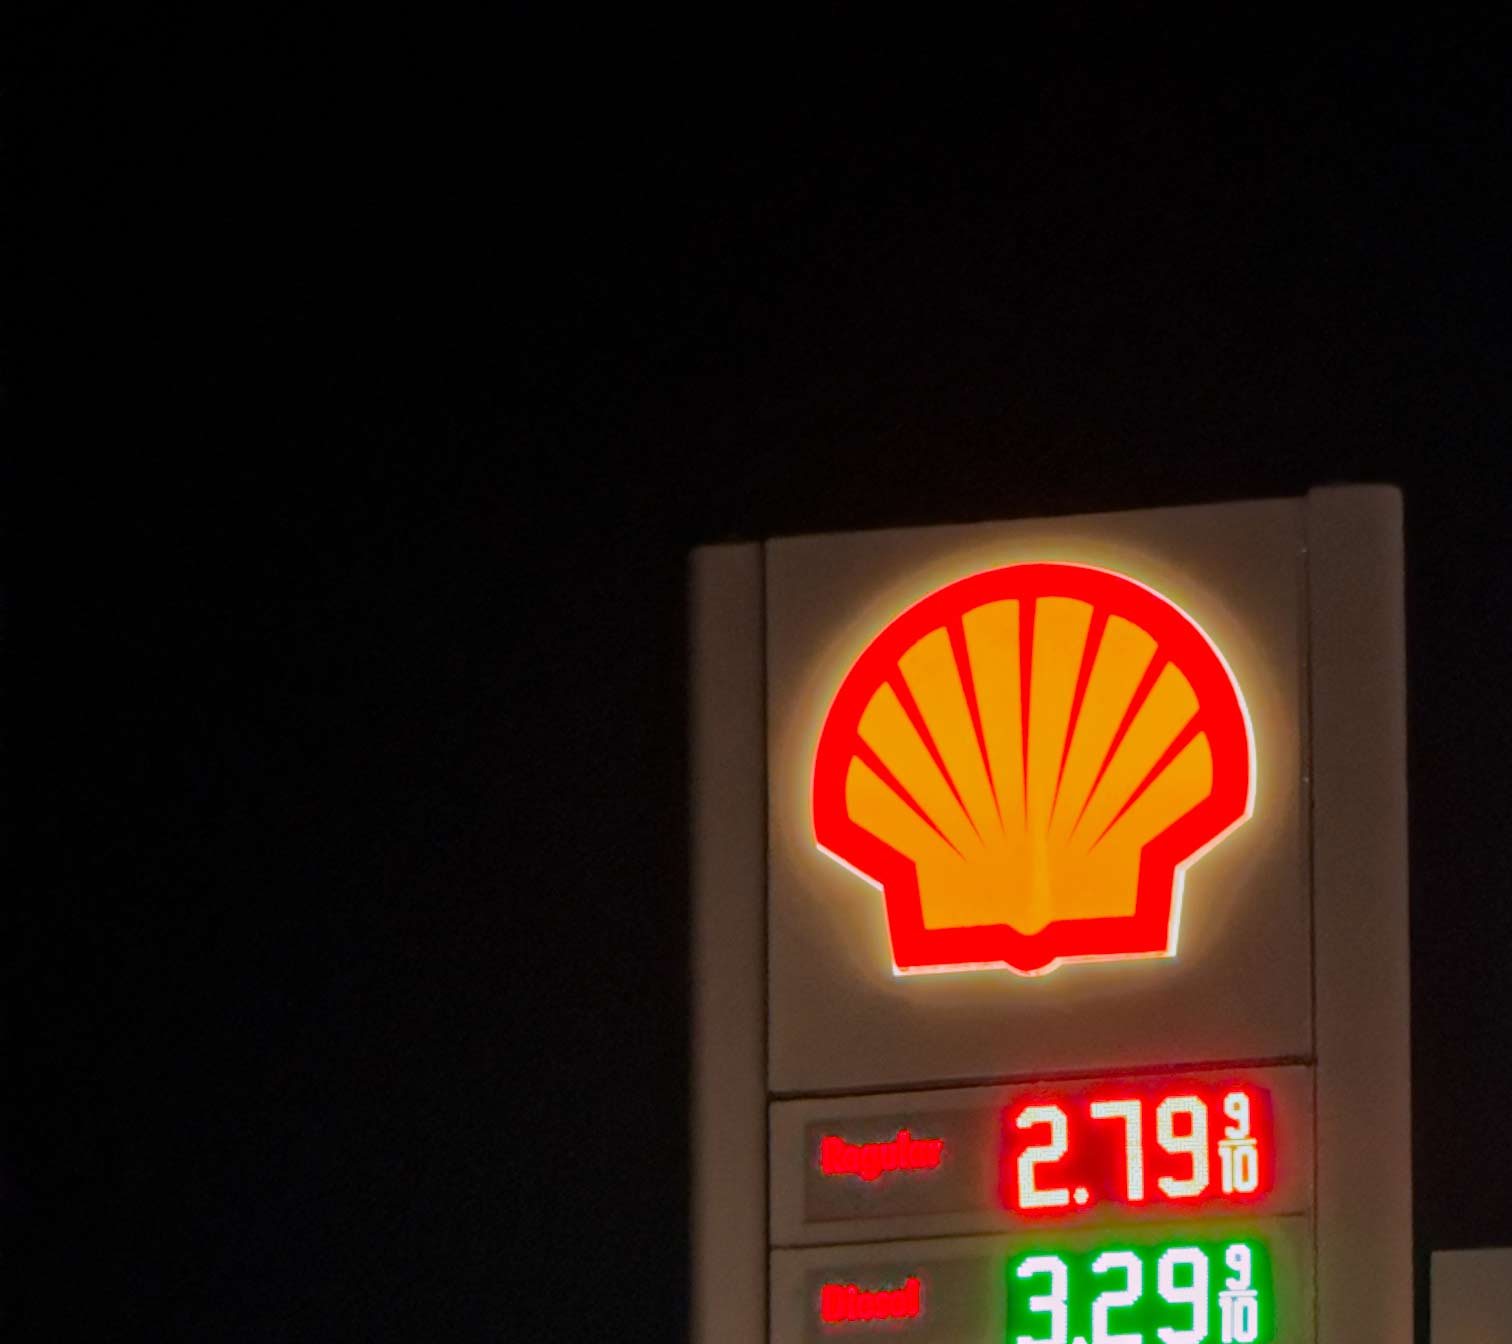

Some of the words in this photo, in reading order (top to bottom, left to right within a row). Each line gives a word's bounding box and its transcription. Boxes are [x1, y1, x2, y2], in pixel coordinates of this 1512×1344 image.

[820, 1128, 943, 1181] Regular
[1015, 1095, 1210, 1209] 2.79
[820, 1276, 920, 1323] Diesel
